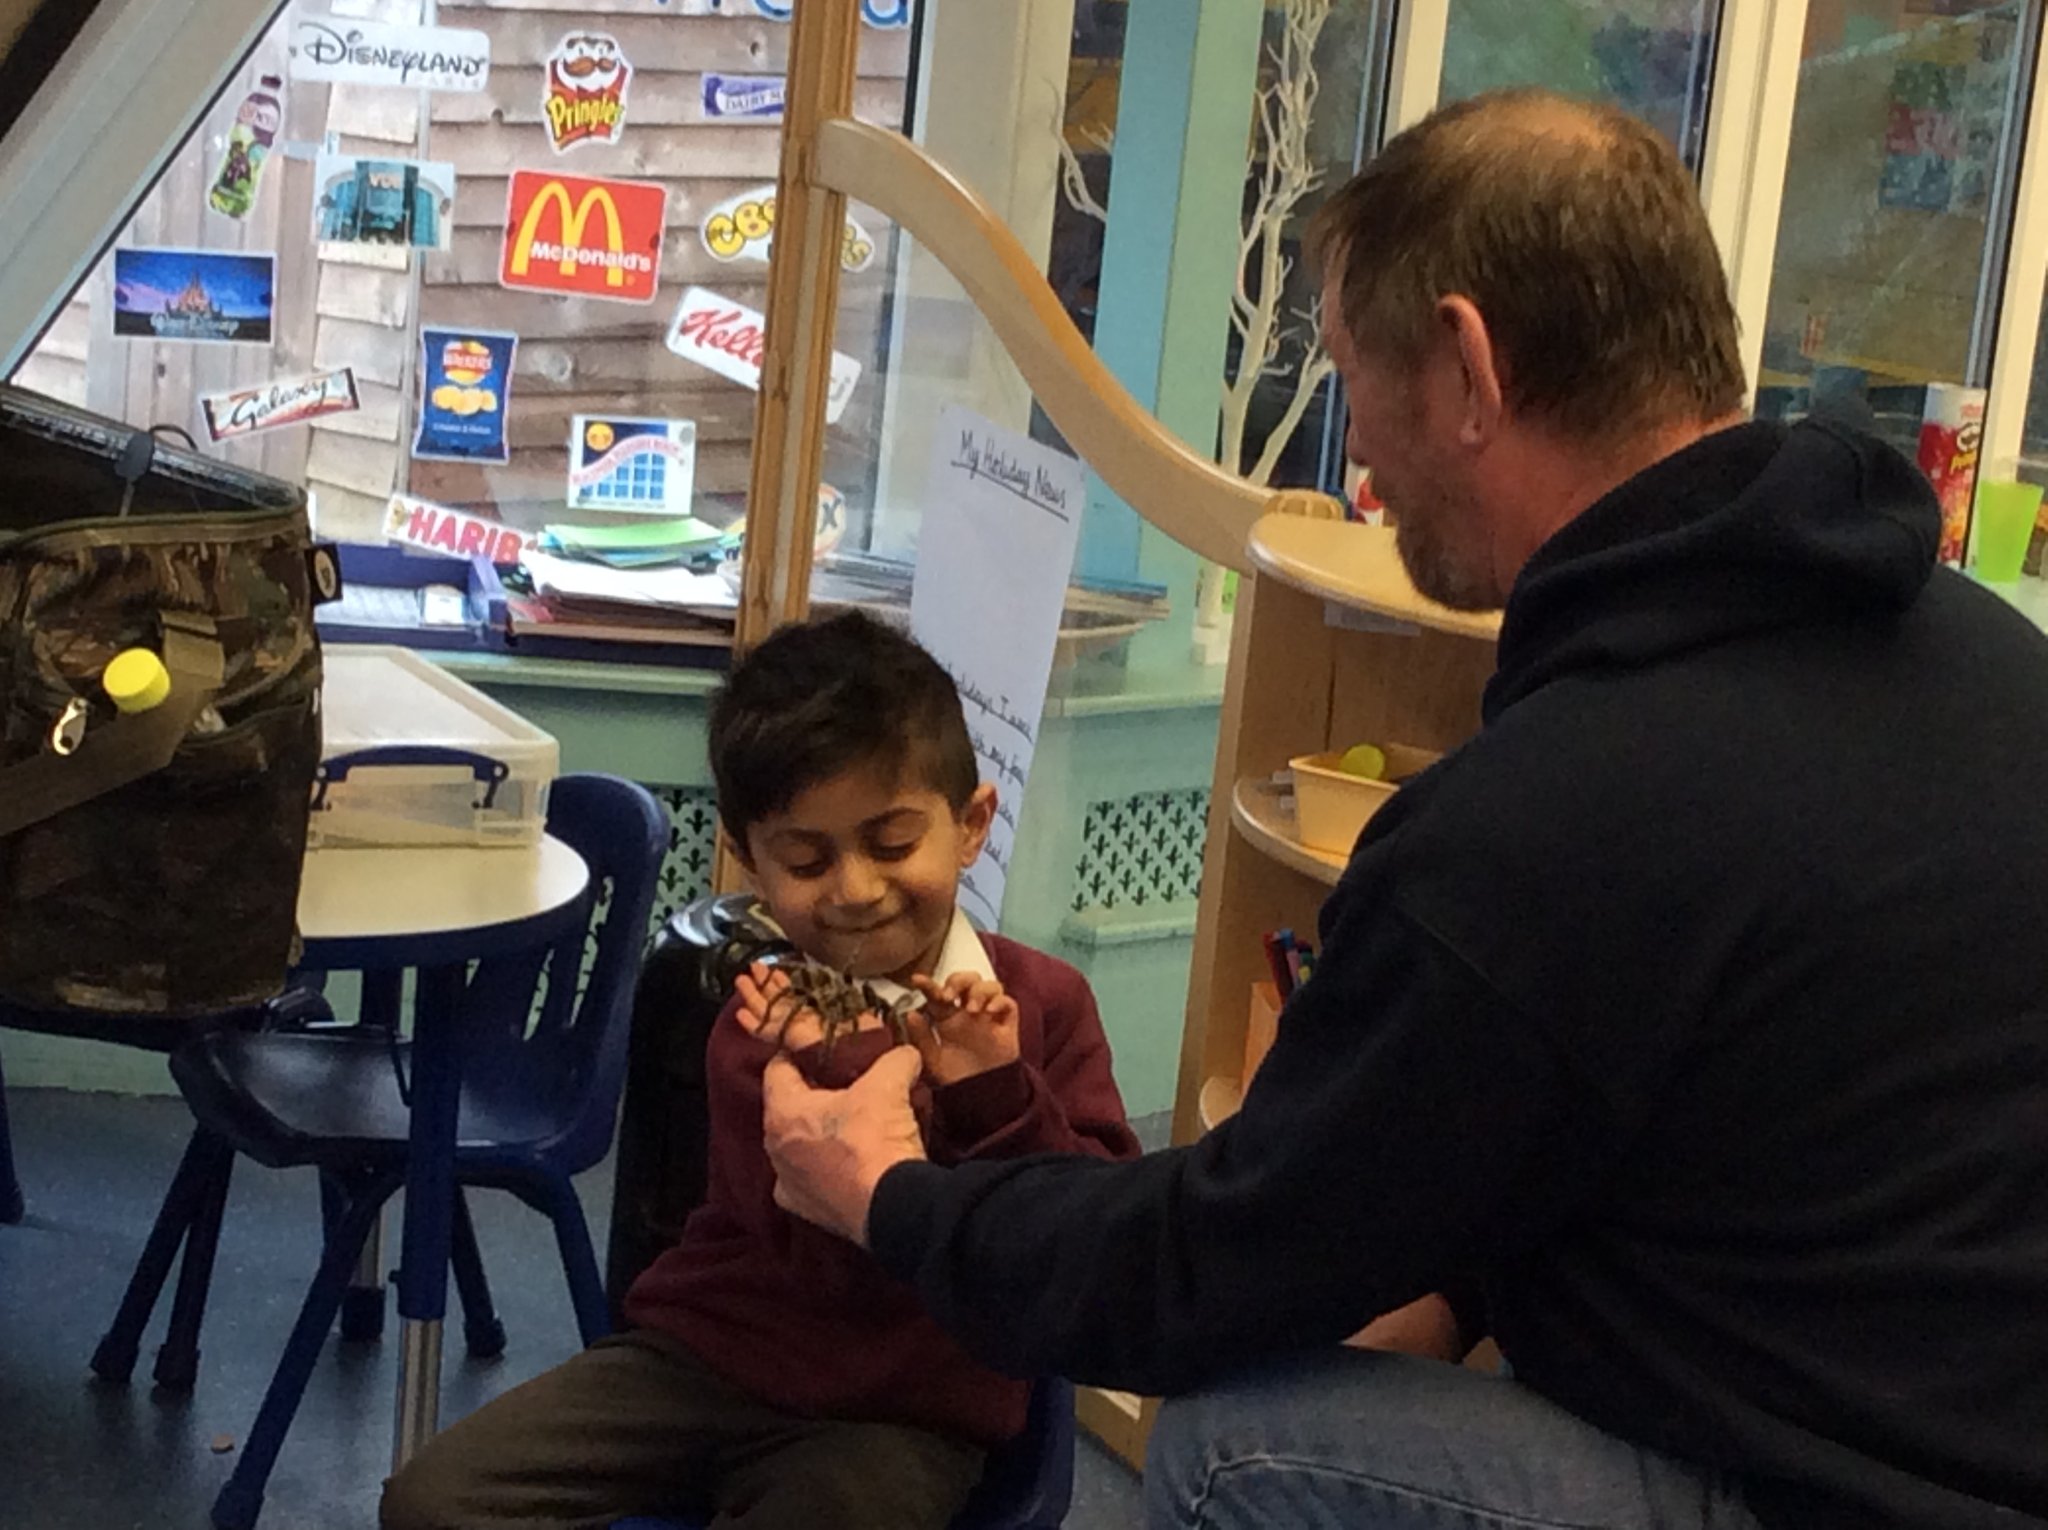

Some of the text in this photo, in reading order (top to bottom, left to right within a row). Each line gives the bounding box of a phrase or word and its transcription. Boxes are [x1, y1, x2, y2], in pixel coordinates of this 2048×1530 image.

[545, 94, 625, 139] Pringles
[530, 240, 651, 273] McDonald's
[960, 429, 979, 480] My
[407, 506, 537, 564] HARIB
